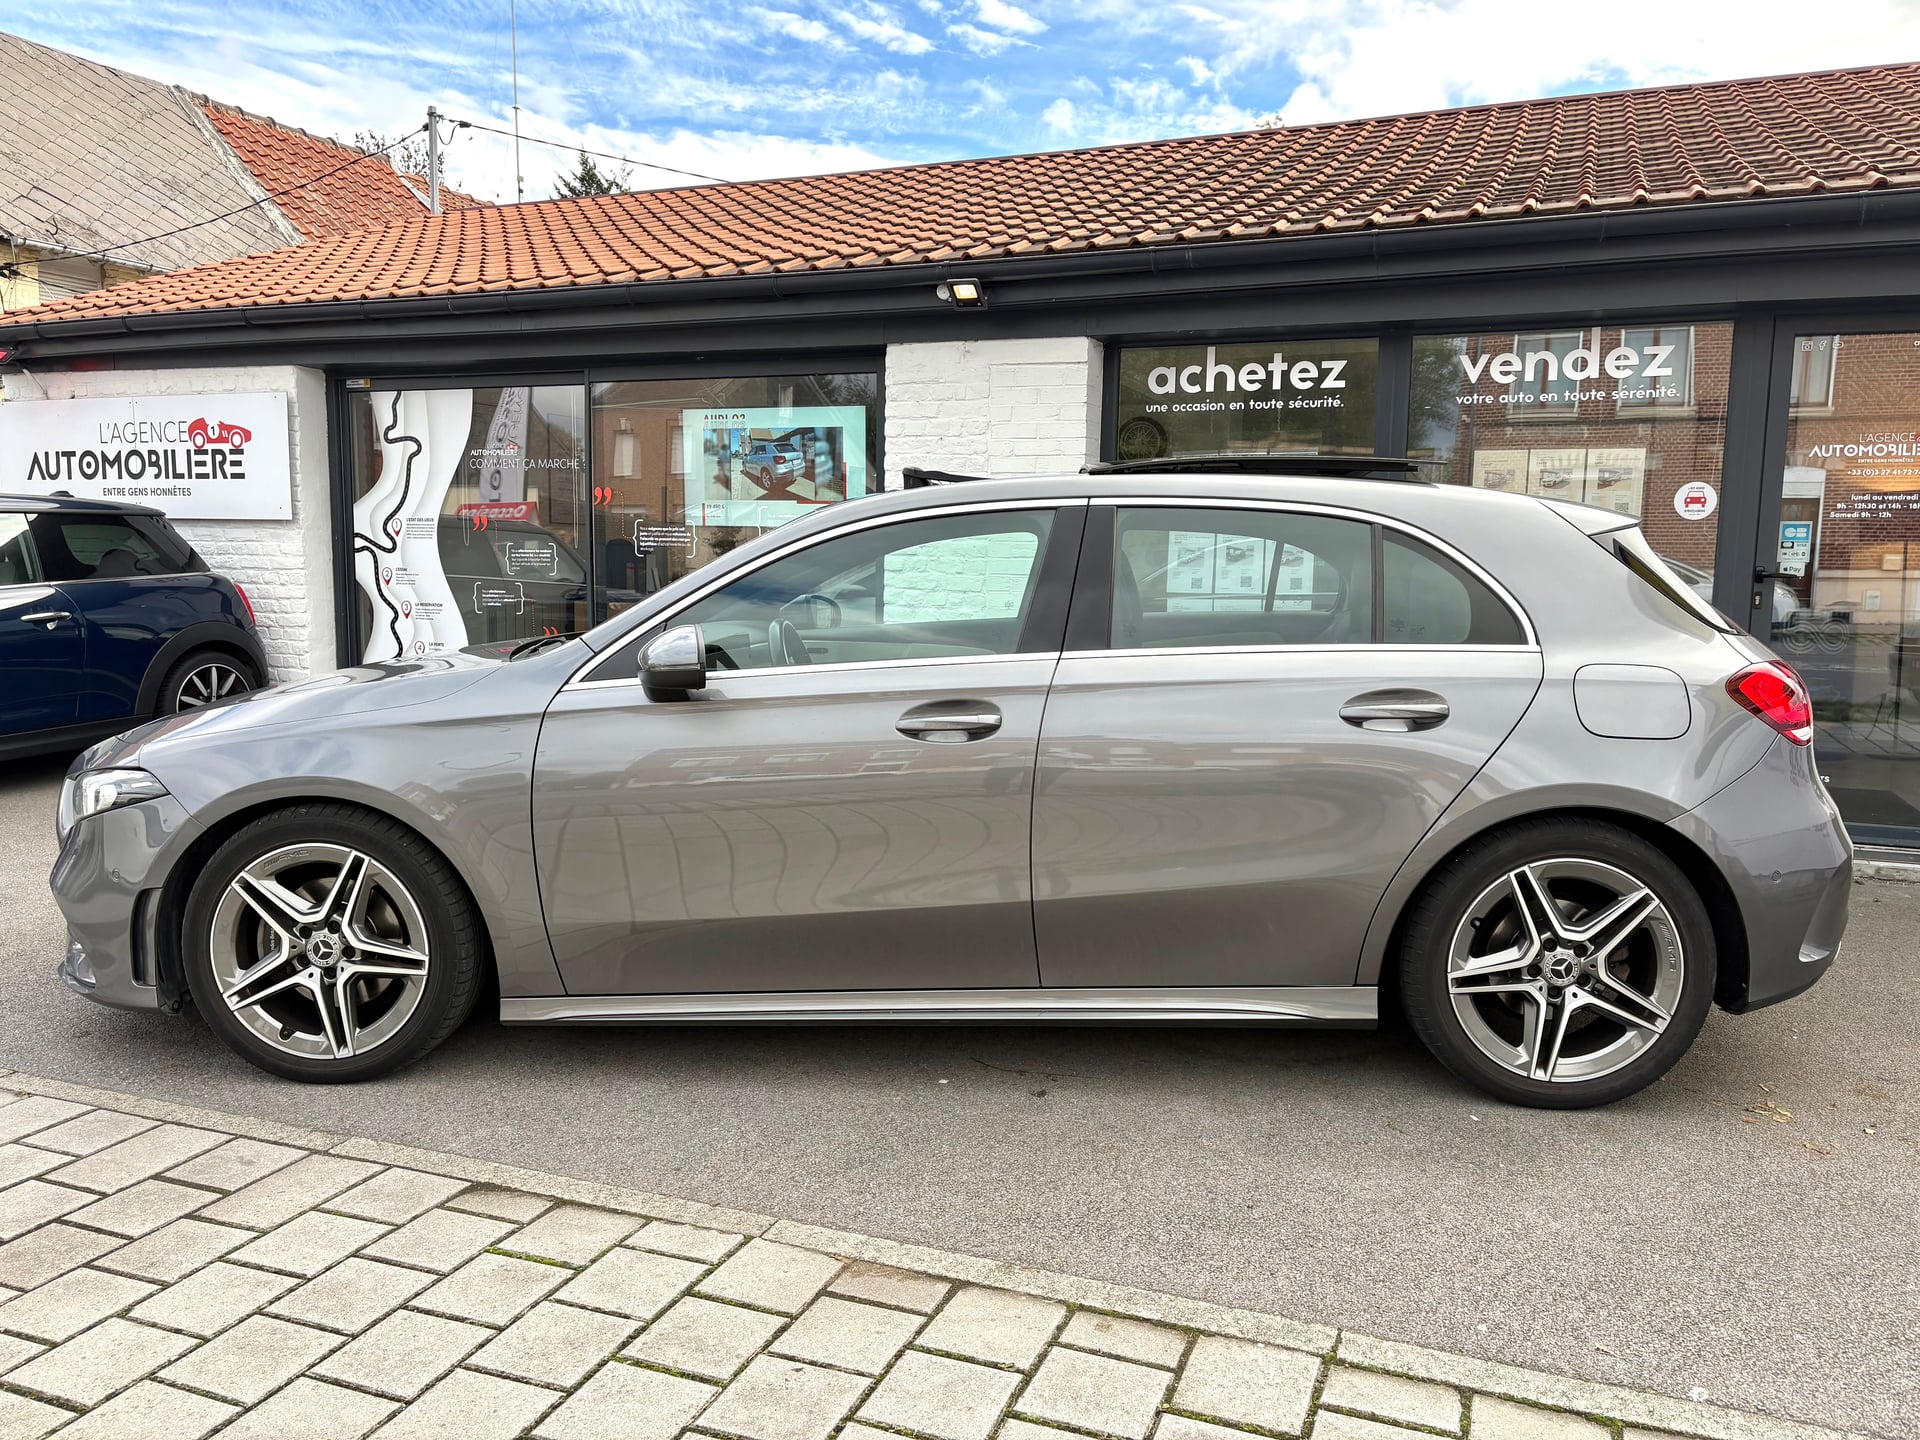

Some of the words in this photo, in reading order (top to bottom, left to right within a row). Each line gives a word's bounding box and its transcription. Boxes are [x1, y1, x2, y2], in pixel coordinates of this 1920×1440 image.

[1459, 327, 1676, 384] vendez
[1147, 346, 1348, 395] achetez
[1145, 402, 1168, 413] une
[1172, 399, 1225, 412] occasion
[1229, 401, 1245, 411] en
[1249, 398, 1284, 410] toute
[1288, 394, 1345, 409] sécurité.
[1456, 393, 1494, 405] votre
[1499, 390, 1534, 403] auto
[1540, 391, 1558, 402] en
[1564, 388, 1606, 401] toute
[1611, 383, 1681, 400] sérénité.
[99, 420, 189, 444] L'AGENCE
[1859, 432, 1916, 443] L'AGENCE
[469, 458, 520, 469] COMMENT
[522, 458, 536, 471] ÇA
[537, 458, 580, 468] MARCHE
[103, 488, 126, 497] ENTRE
[128, 487, 149, 497] GENS
[150, 485, 192, 497] HONNÊTES
